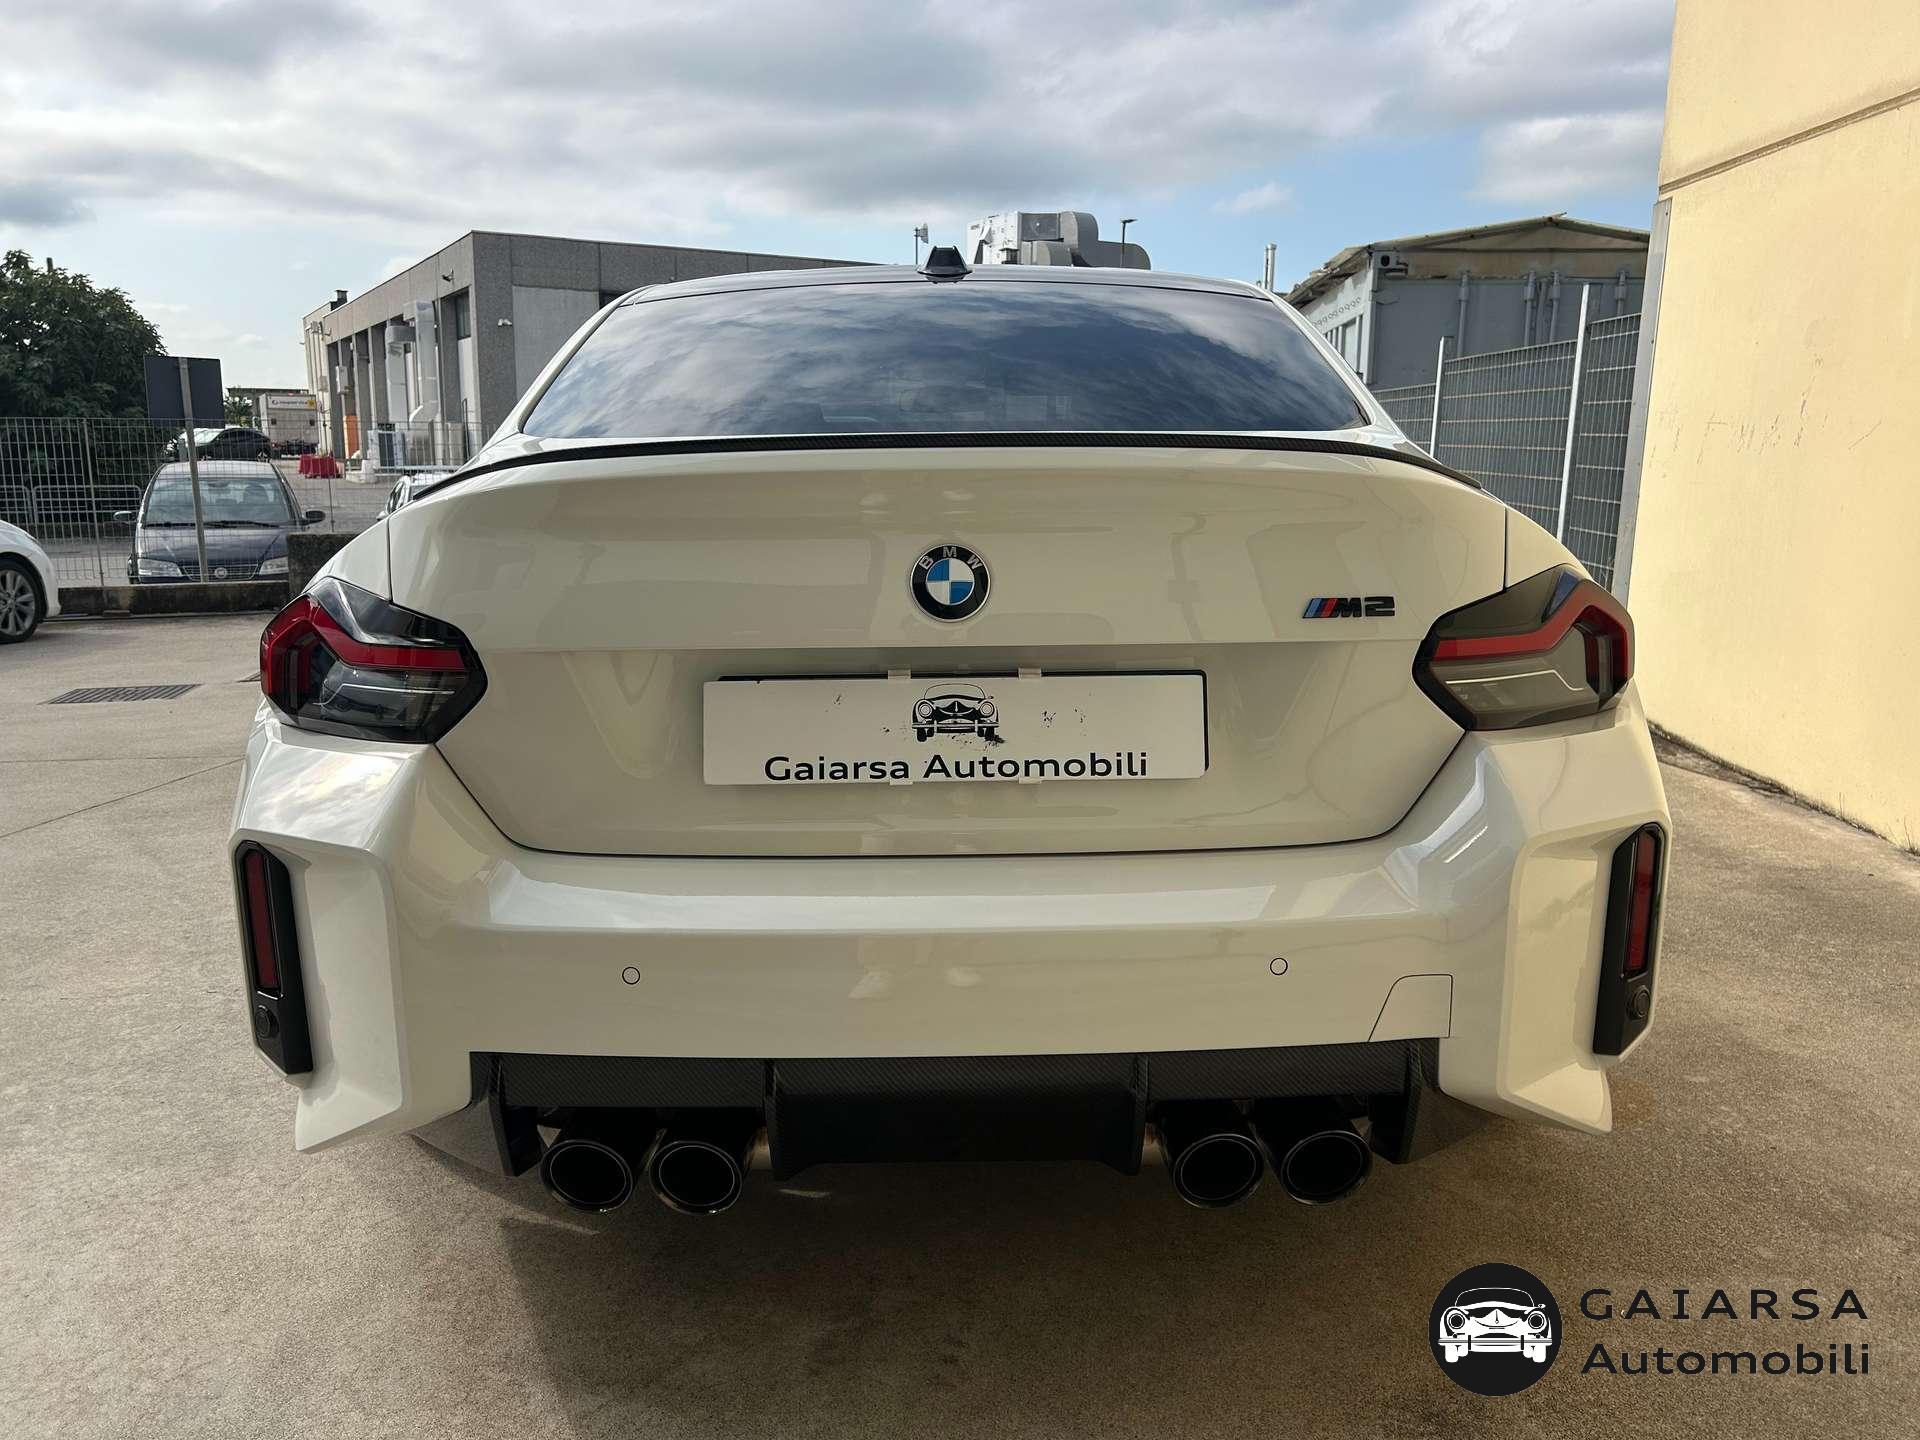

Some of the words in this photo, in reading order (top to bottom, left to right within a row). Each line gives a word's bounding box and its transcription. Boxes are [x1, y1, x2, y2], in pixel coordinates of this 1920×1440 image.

[919, 546, 982, 570] BMW
[1303, 596, 1395, 618] M2
[764, 755, 910, 782] Gaiarsa
[923, 752, 1148, 780] Automobili
